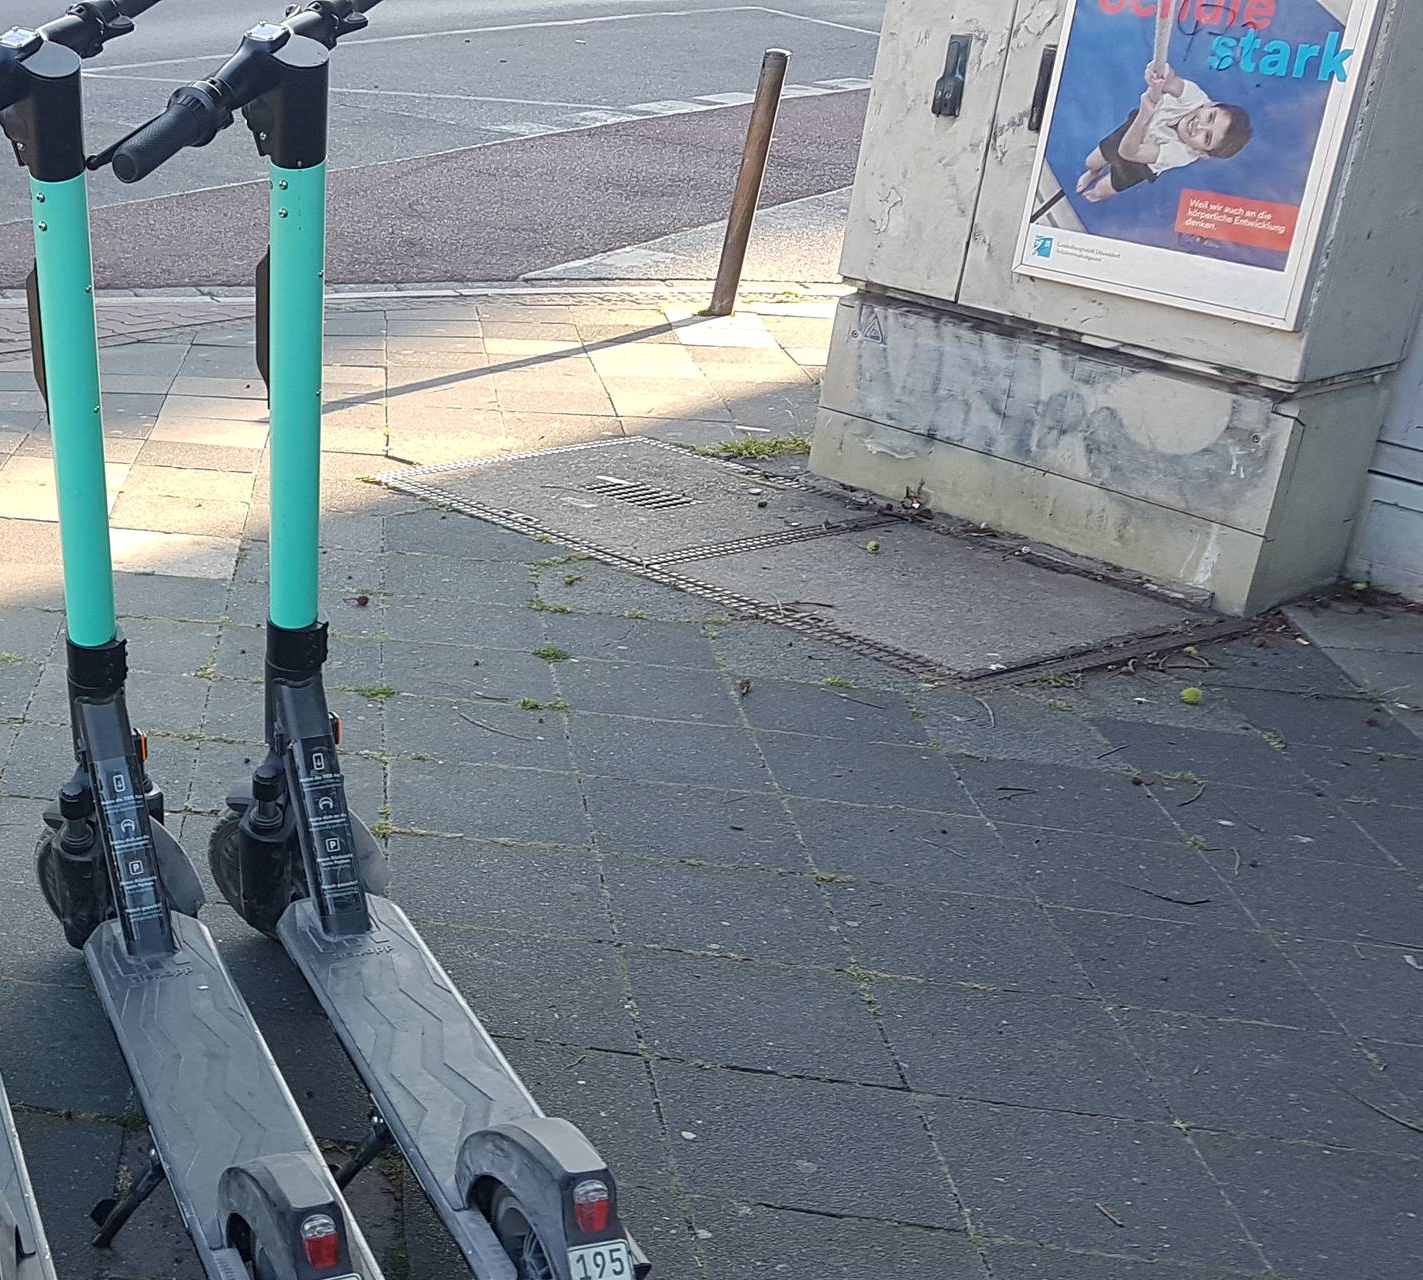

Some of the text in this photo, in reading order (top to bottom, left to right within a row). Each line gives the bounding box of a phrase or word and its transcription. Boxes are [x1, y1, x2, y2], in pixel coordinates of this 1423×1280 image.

[1207, 30, 1354, 82] stark
[1186, 208, 1286, 234] körperliche Entwicklung
[1189, 198, 1272, 220] Weil wir auch an die
[1185, 218, 1217, 231] denken.
[576, 1247, 625, 1280] 195
